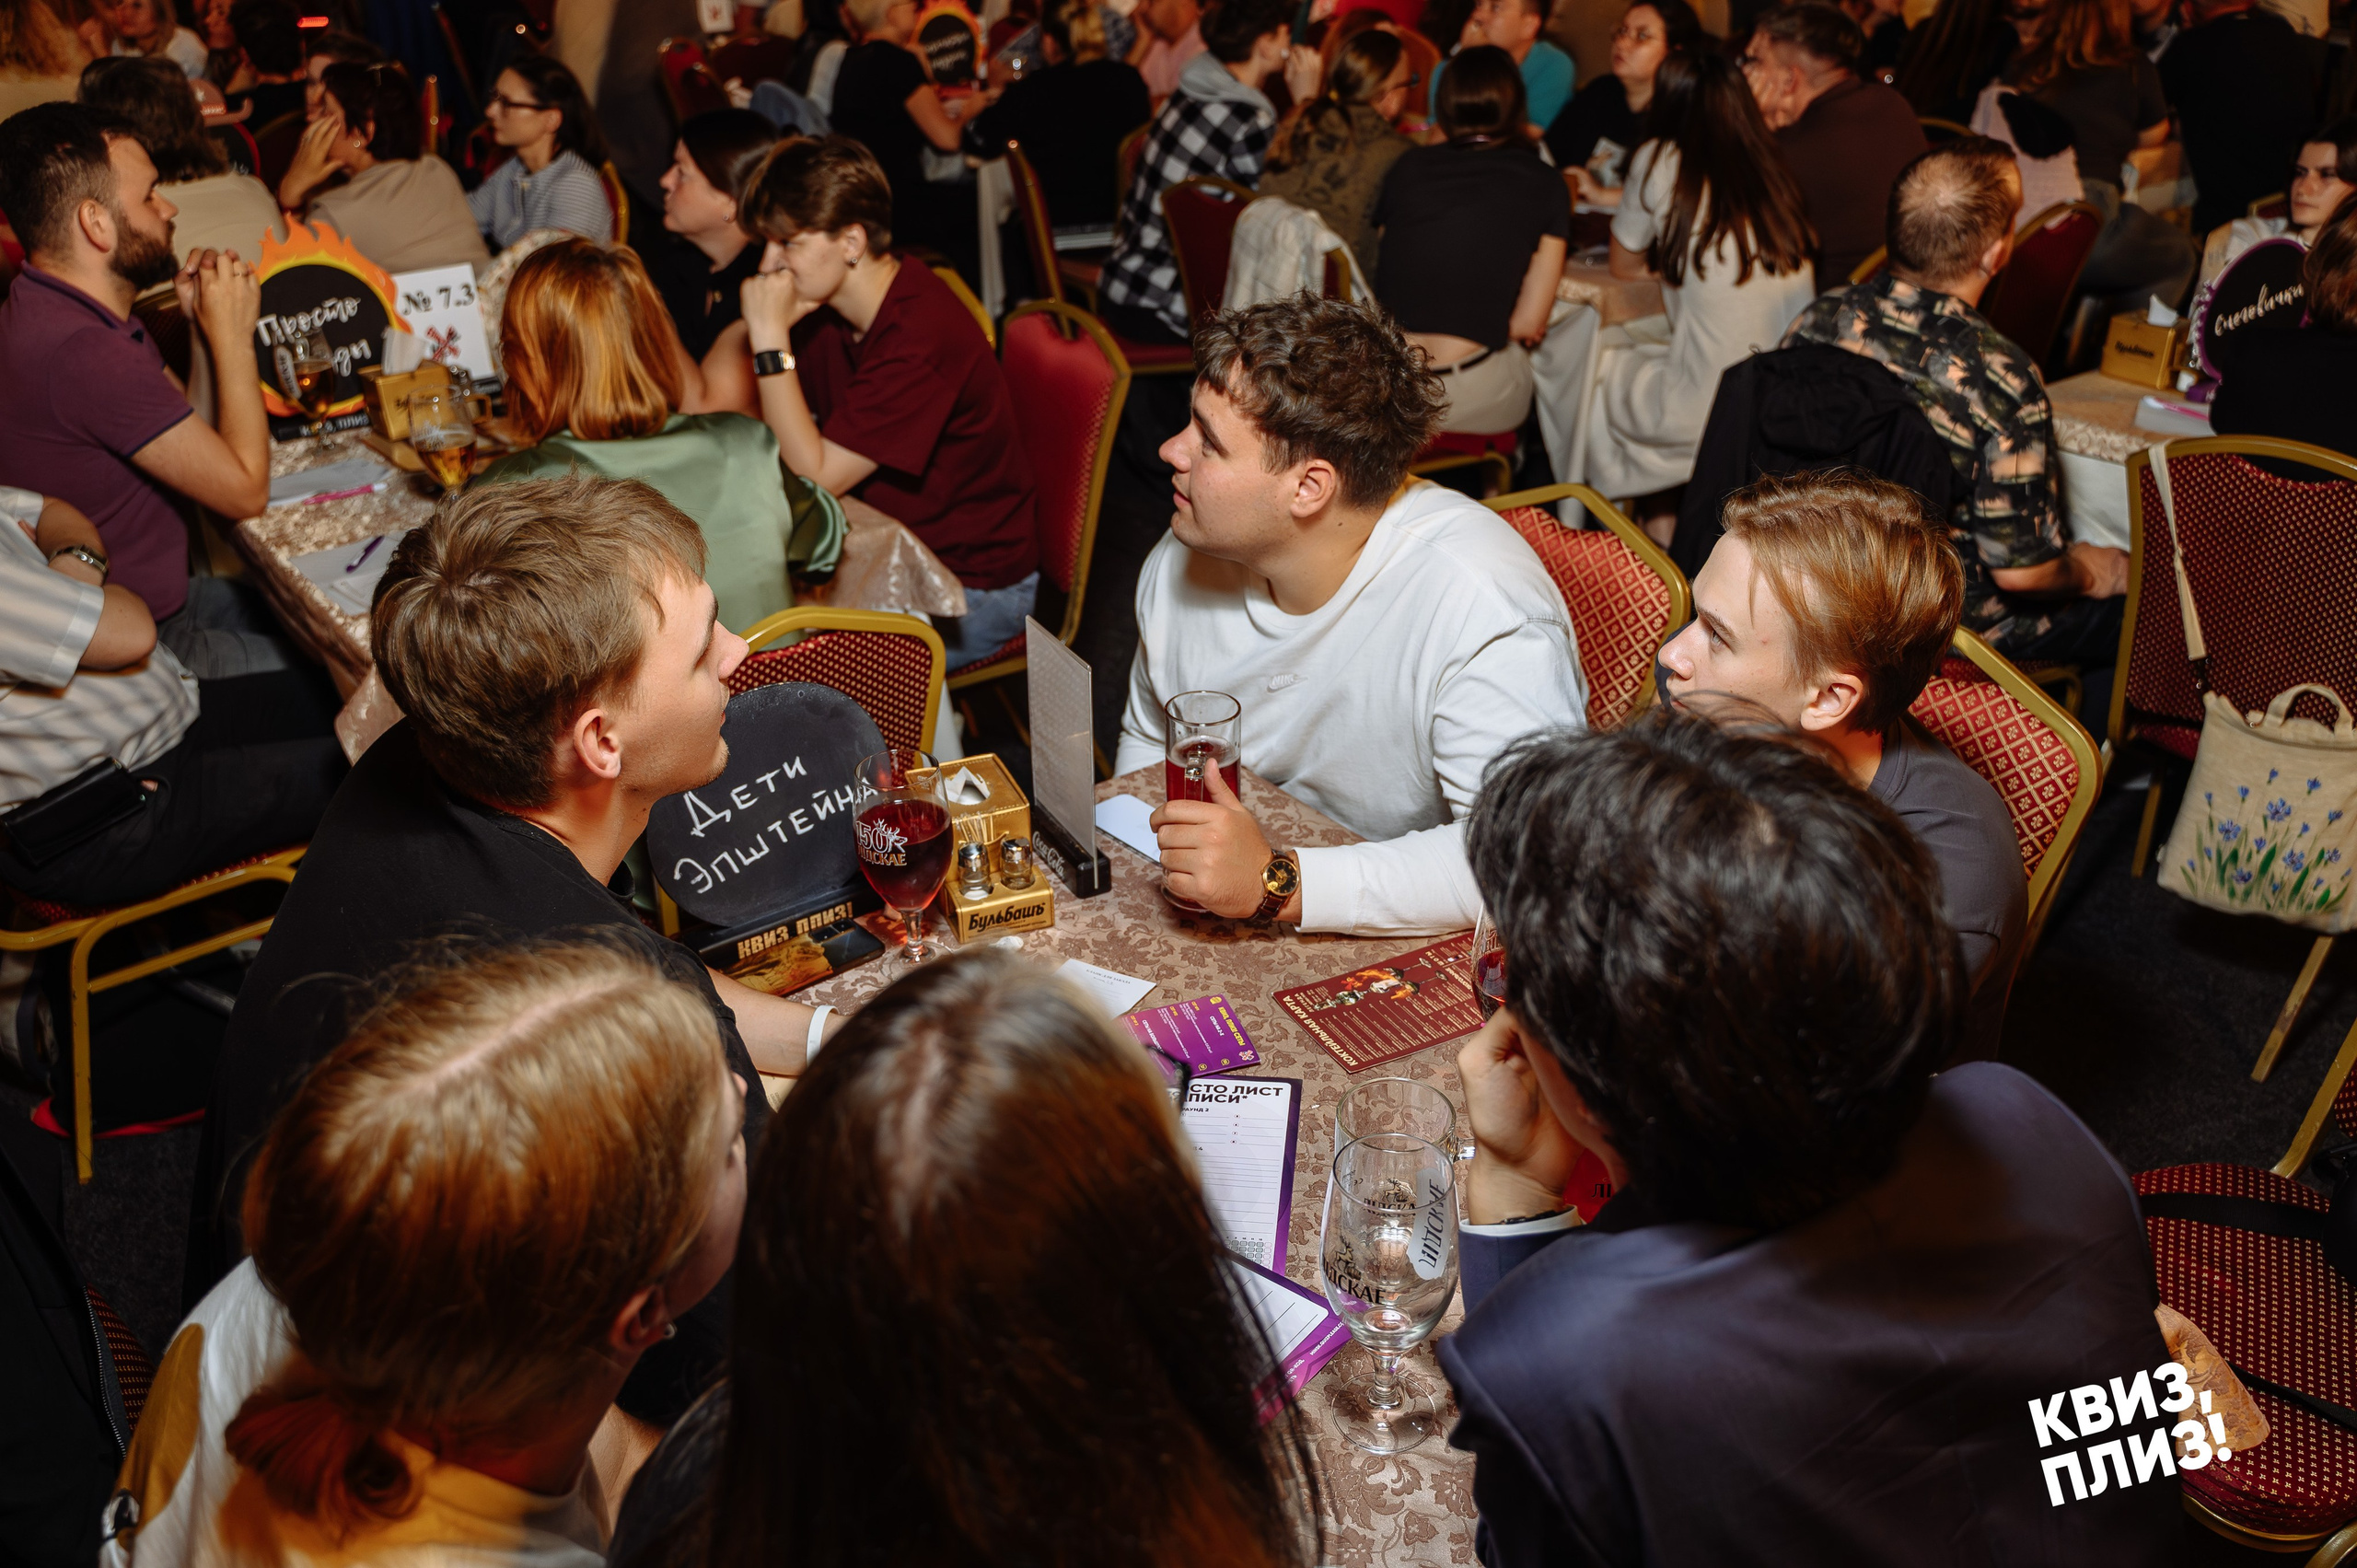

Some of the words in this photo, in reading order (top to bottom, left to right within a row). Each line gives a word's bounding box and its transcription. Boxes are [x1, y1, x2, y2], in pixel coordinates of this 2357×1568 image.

[401, 289, 433, 316] №
[436, 283, 475, 309] 7.3
[256, 296, 362, 346] Просто
[673, 777, 878, 894] ЭПШТЕЙНА
[969, 902, 1046, 933] Бульбашъ
[1283, 994, 1309, 1019] КАРТА
[1304, 1017, 1359, 1067] КОКТЕЙЛЬНАЯ
[1185, 1093, 1248, 1103] ПИСИ
[1190, 1084, 1228, 1093] СТО
[1232, 1086, 1283, 1096] ЛИСТ
